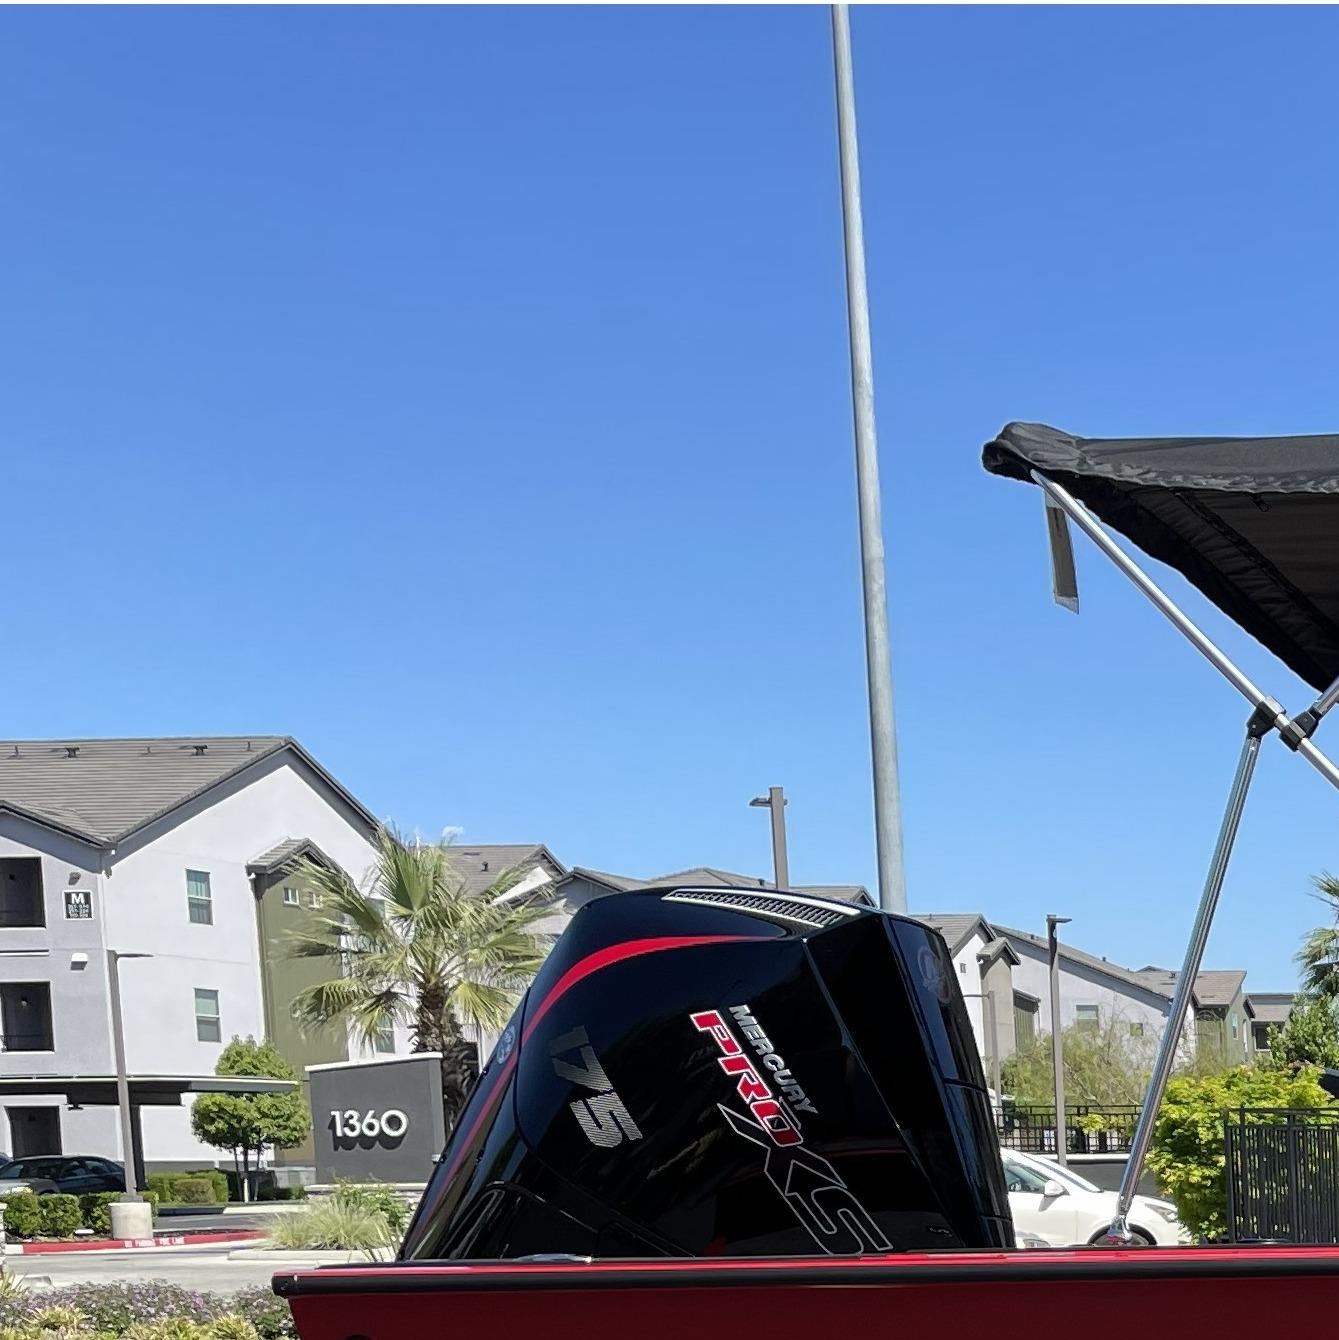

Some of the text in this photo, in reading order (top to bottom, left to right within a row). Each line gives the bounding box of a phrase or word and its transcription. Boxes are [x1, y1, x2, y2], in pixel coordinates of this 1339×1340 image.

[71, 893, 85, 904] M
[689, 1010, 803, 1147] PRO
[728, 1004, 819, 1114] MERCURY
[331, 1109, 408, 1137] 1360
